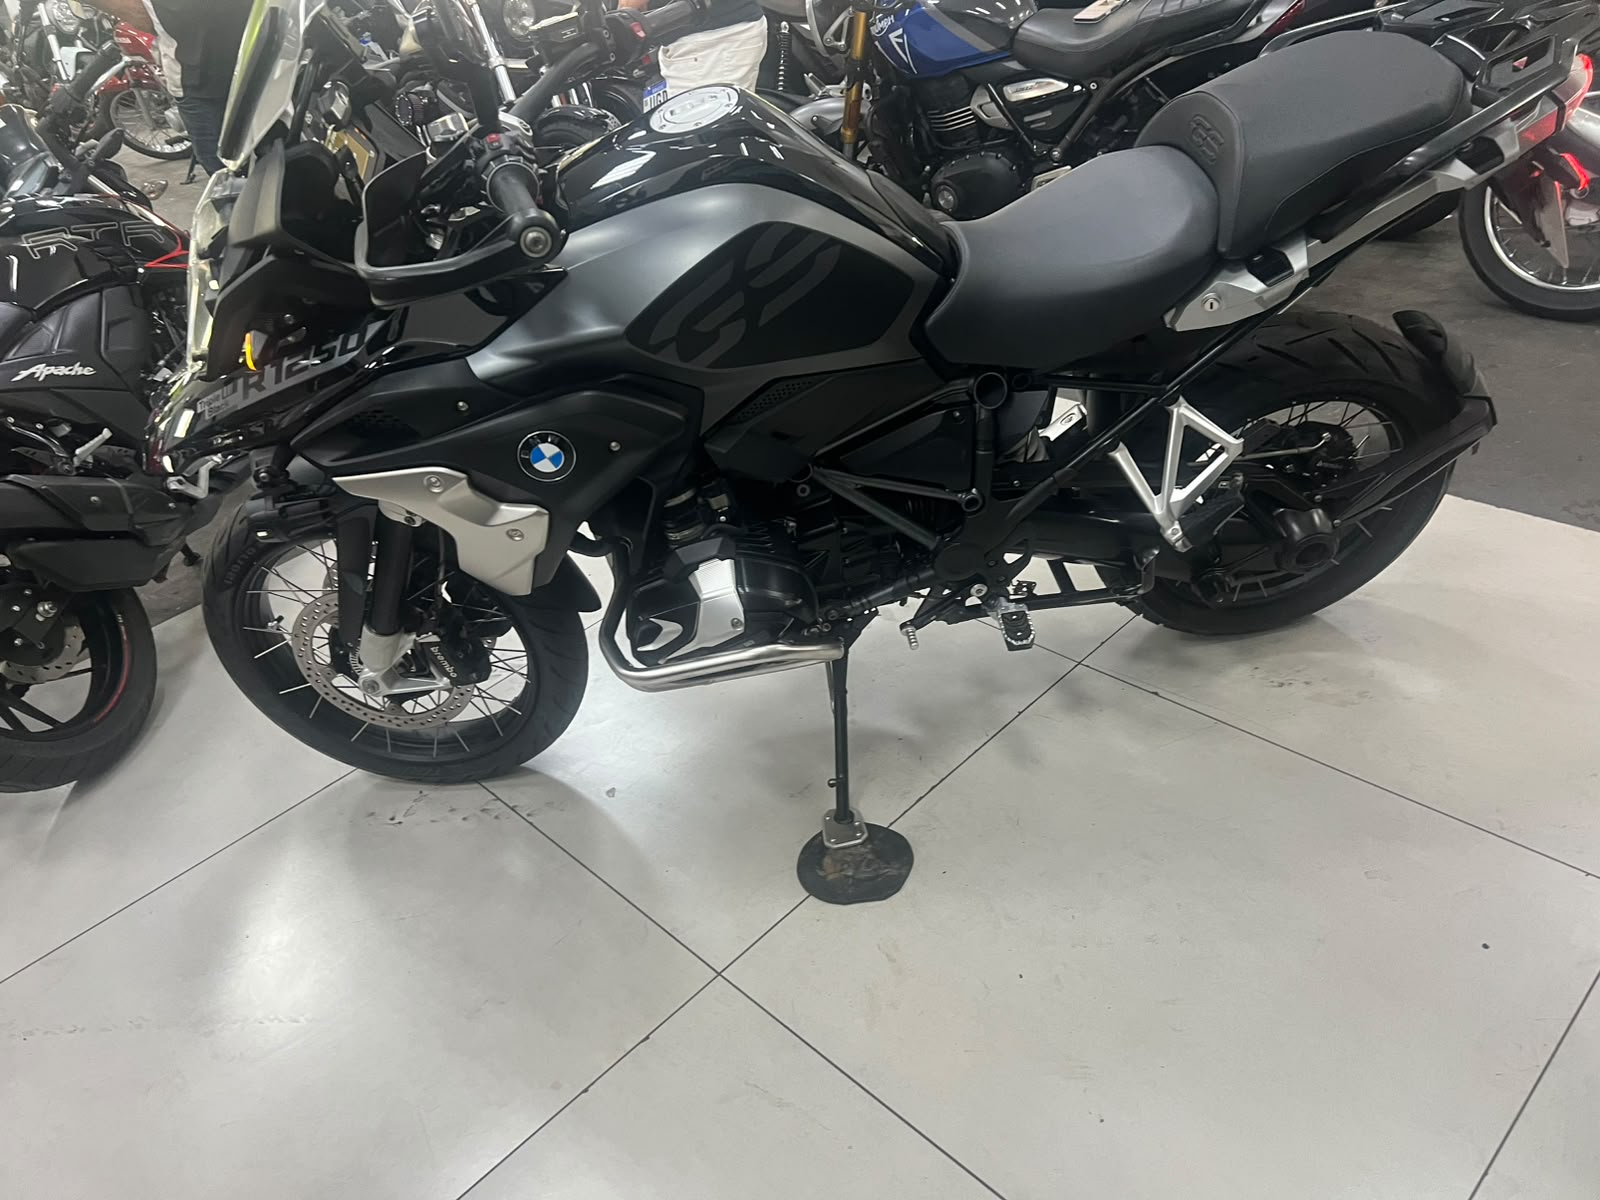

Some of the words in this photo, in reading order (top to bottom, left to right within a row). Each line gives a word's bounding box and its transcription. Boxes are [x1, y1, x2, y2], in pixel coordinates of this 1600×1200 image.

[21, 219, 165, 260] RTR
[11, 361, 97, 382] Apache
[430, 646, 457, 678] brembo
